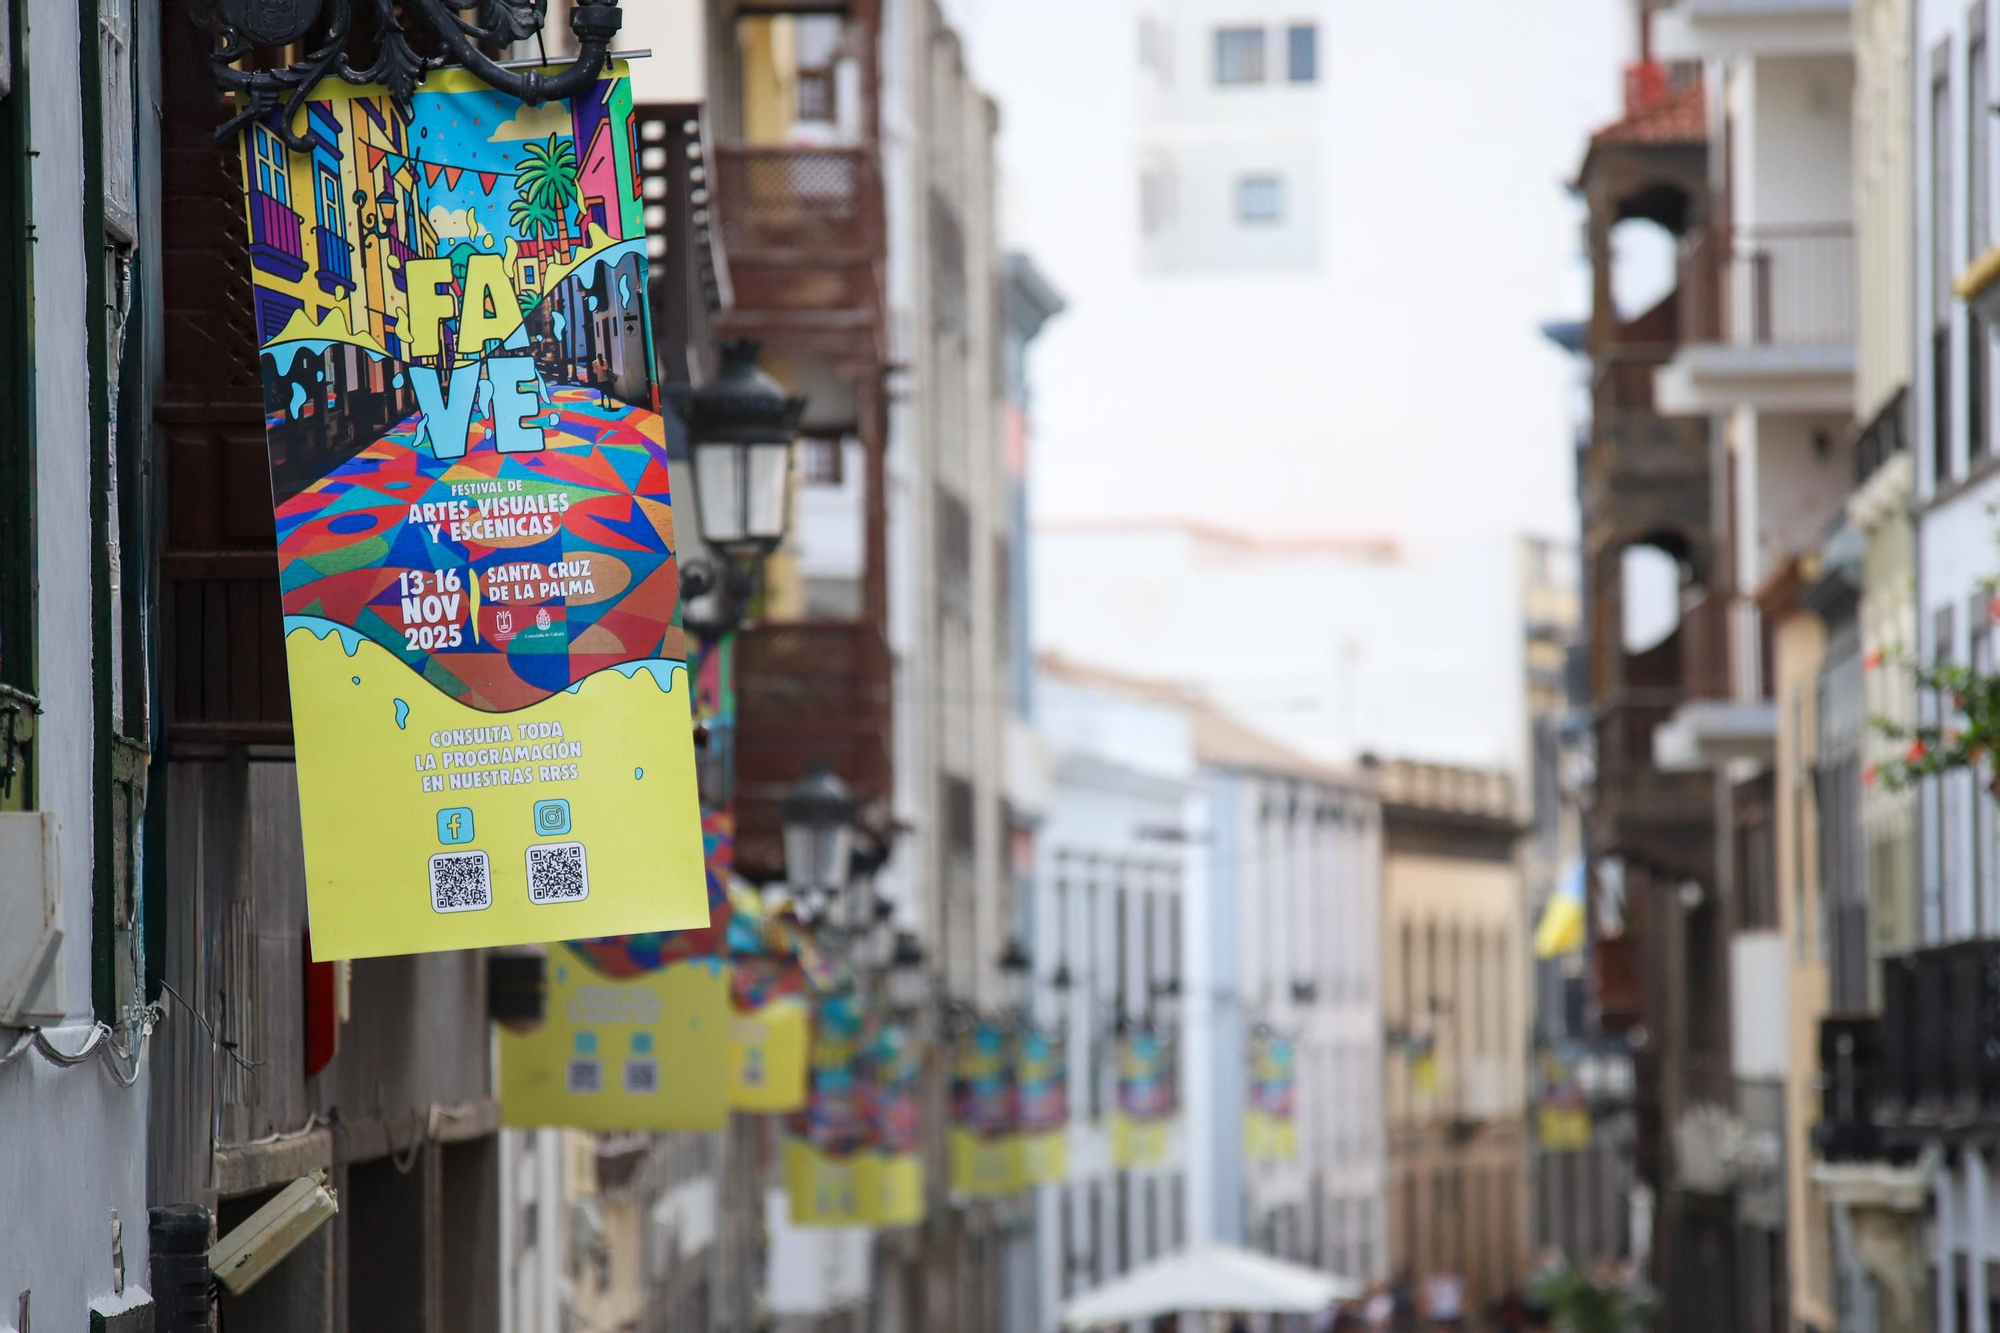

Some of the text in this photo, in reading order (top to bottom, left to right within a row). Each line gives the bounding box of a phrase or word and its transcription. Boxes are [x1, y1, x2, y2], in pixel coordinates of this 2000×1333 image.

[405, 253, 530, 358] FA
[407, 356, 545, 459] VE
[451, 479, 523, 496] FESTIVAL DE
[408, 493, 569, 524] ARTES VISUALES
[427, 514, 554, 544] Y ESCÉNICAS
[487, 559, 592, 584] SANTA CRUZ
[488, 578, 596, 602] DE LA PALMA
[401, 593, 461, 625] NOV
[404, 624, 463, 652] 2025
[430, 721, 563, 748] CONSULTA TODA
[415, 738, 582, 772] LA PROGRAMACIÓN
[422, 763, 579, 792] EN NUESTRAS RRSS
